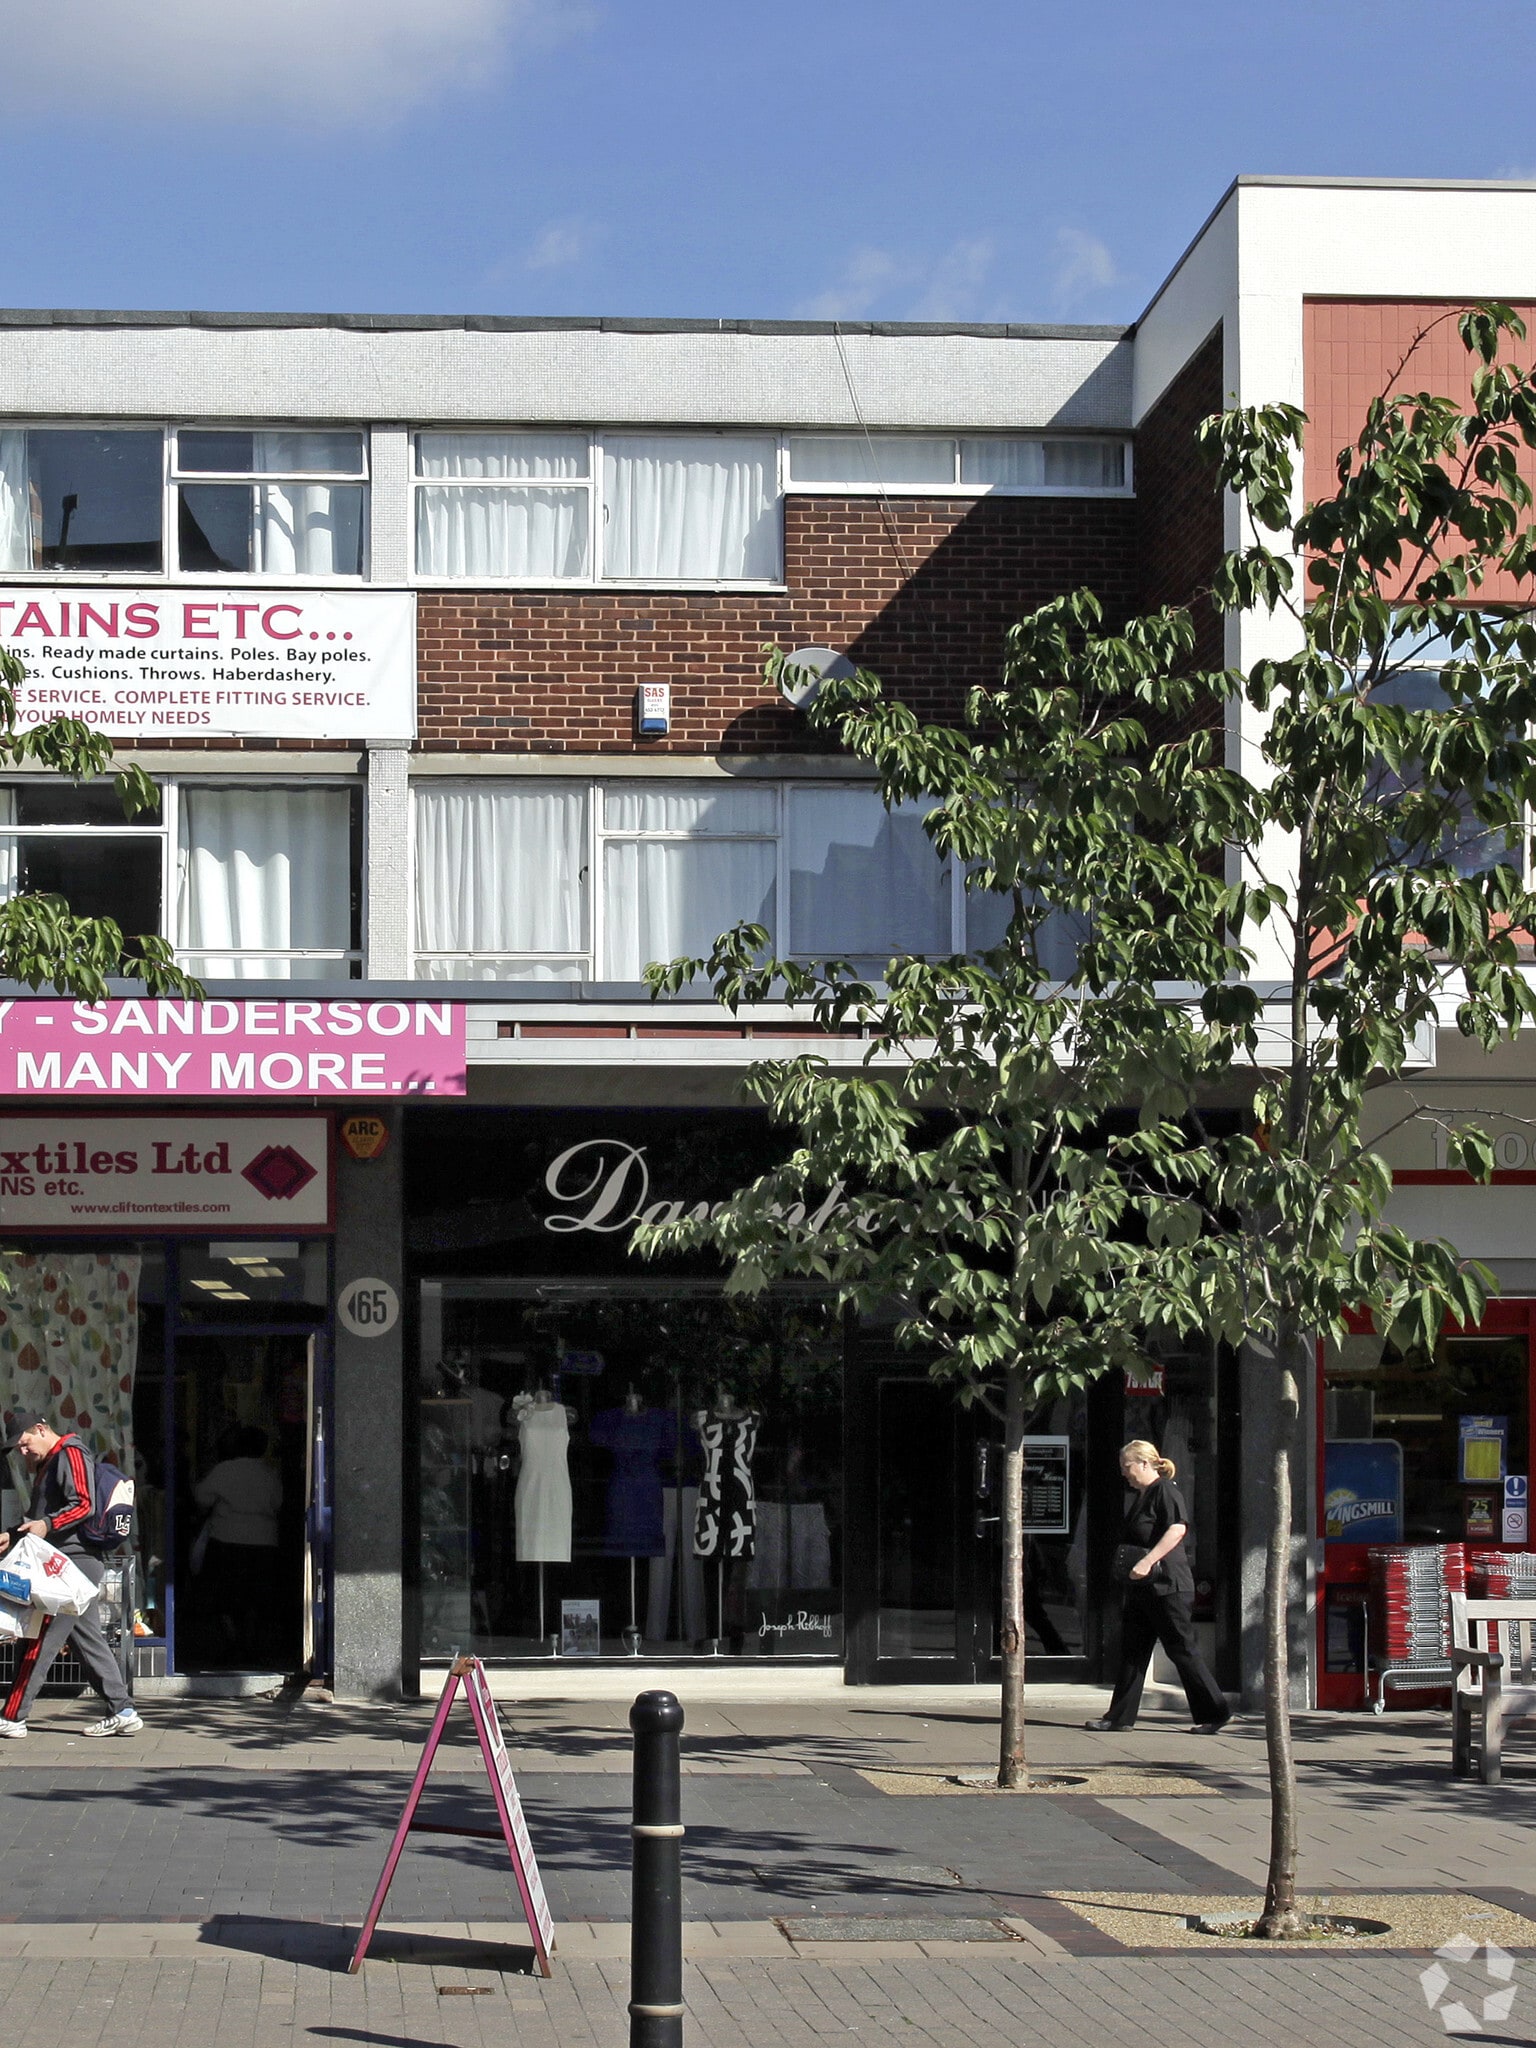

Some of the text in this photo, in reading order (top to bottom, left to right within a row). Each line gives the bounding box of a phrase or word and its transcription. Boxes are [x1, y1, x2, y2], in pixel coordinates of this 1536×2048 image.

[182, 602, 353, 641] ETC...
[42, 645, 95, 662] Ready
[99, 646, 147, 660] made
[150, 647, 224, 660] curtains.
[231, 647, 280, 661] Poles.
[286, 648, 317, 665] Bay
[321, 648, 371, 666] poles.
[51, 665, 133, 680] Cushions.
[139, 666, 205, 681] Throws.
[213, 667, 337, 685] Haberdashery.
[27, 689, 107, 704] SERVICE.
[114, 690, 211, 705] COMPLETE
[216, 691, 287, 706] FITTING
[292, 692, 371, 706] SERVICE.
[644, 687, 665, 697] SAS
[71, 710, 146, 724] HOMELY
[152, 711, 211, 725] NEEDS
[71, 1001, 452, 1036] SANDERSON
[17, 1052, 435, 1090] MANY MORE...
[348, 1121, 379, 1136] ARC
[151, 1142, 232, 1174] Ltd
[1, 1178, 84, 1196] NS etc.
[71, 1202, 231, 1214] www.cliftontextiles.com
[357, 1290, 387, 1325] 65
[1472, 1500, 1489, 1511] 25
[758, 1611, 797, 1637] Joseph
